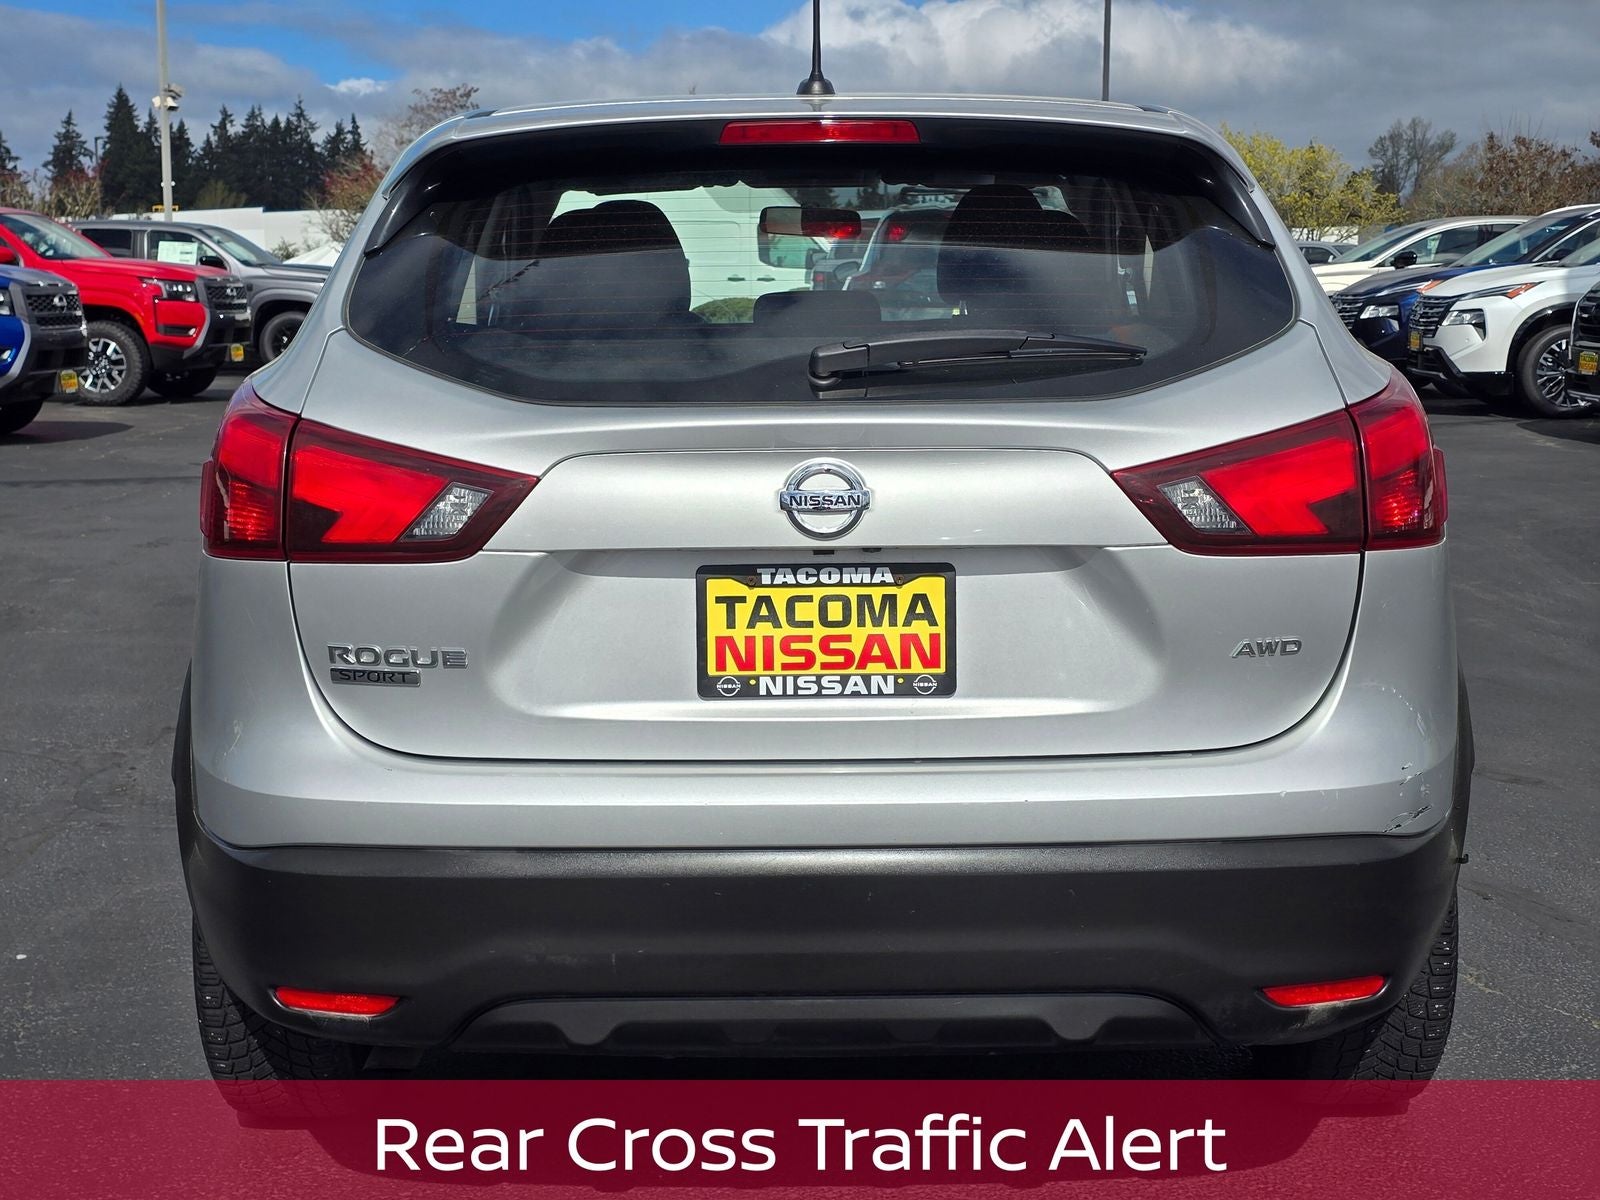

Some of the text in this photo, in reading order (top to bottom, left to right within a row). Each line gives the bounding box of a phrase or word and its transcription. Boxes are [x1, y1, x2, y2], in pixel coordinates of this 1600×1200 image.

[789, 494, 861, 507] NISSAN
[756, 567, 895, 585] TACOMA
[714, 593, 939, 630] TACOMA
[327, 644, 468, 669] ROGUE
[714, 632, 941, 672] NISSAN
[1231, 637, 1302, 658] AWD
[339, 669, 411, 684] SPORT
[716, 682, 742, 690] NISSAN
[759, 675, 895, 696] NISSAN
[912, 681, 938, 689] NISSAN
